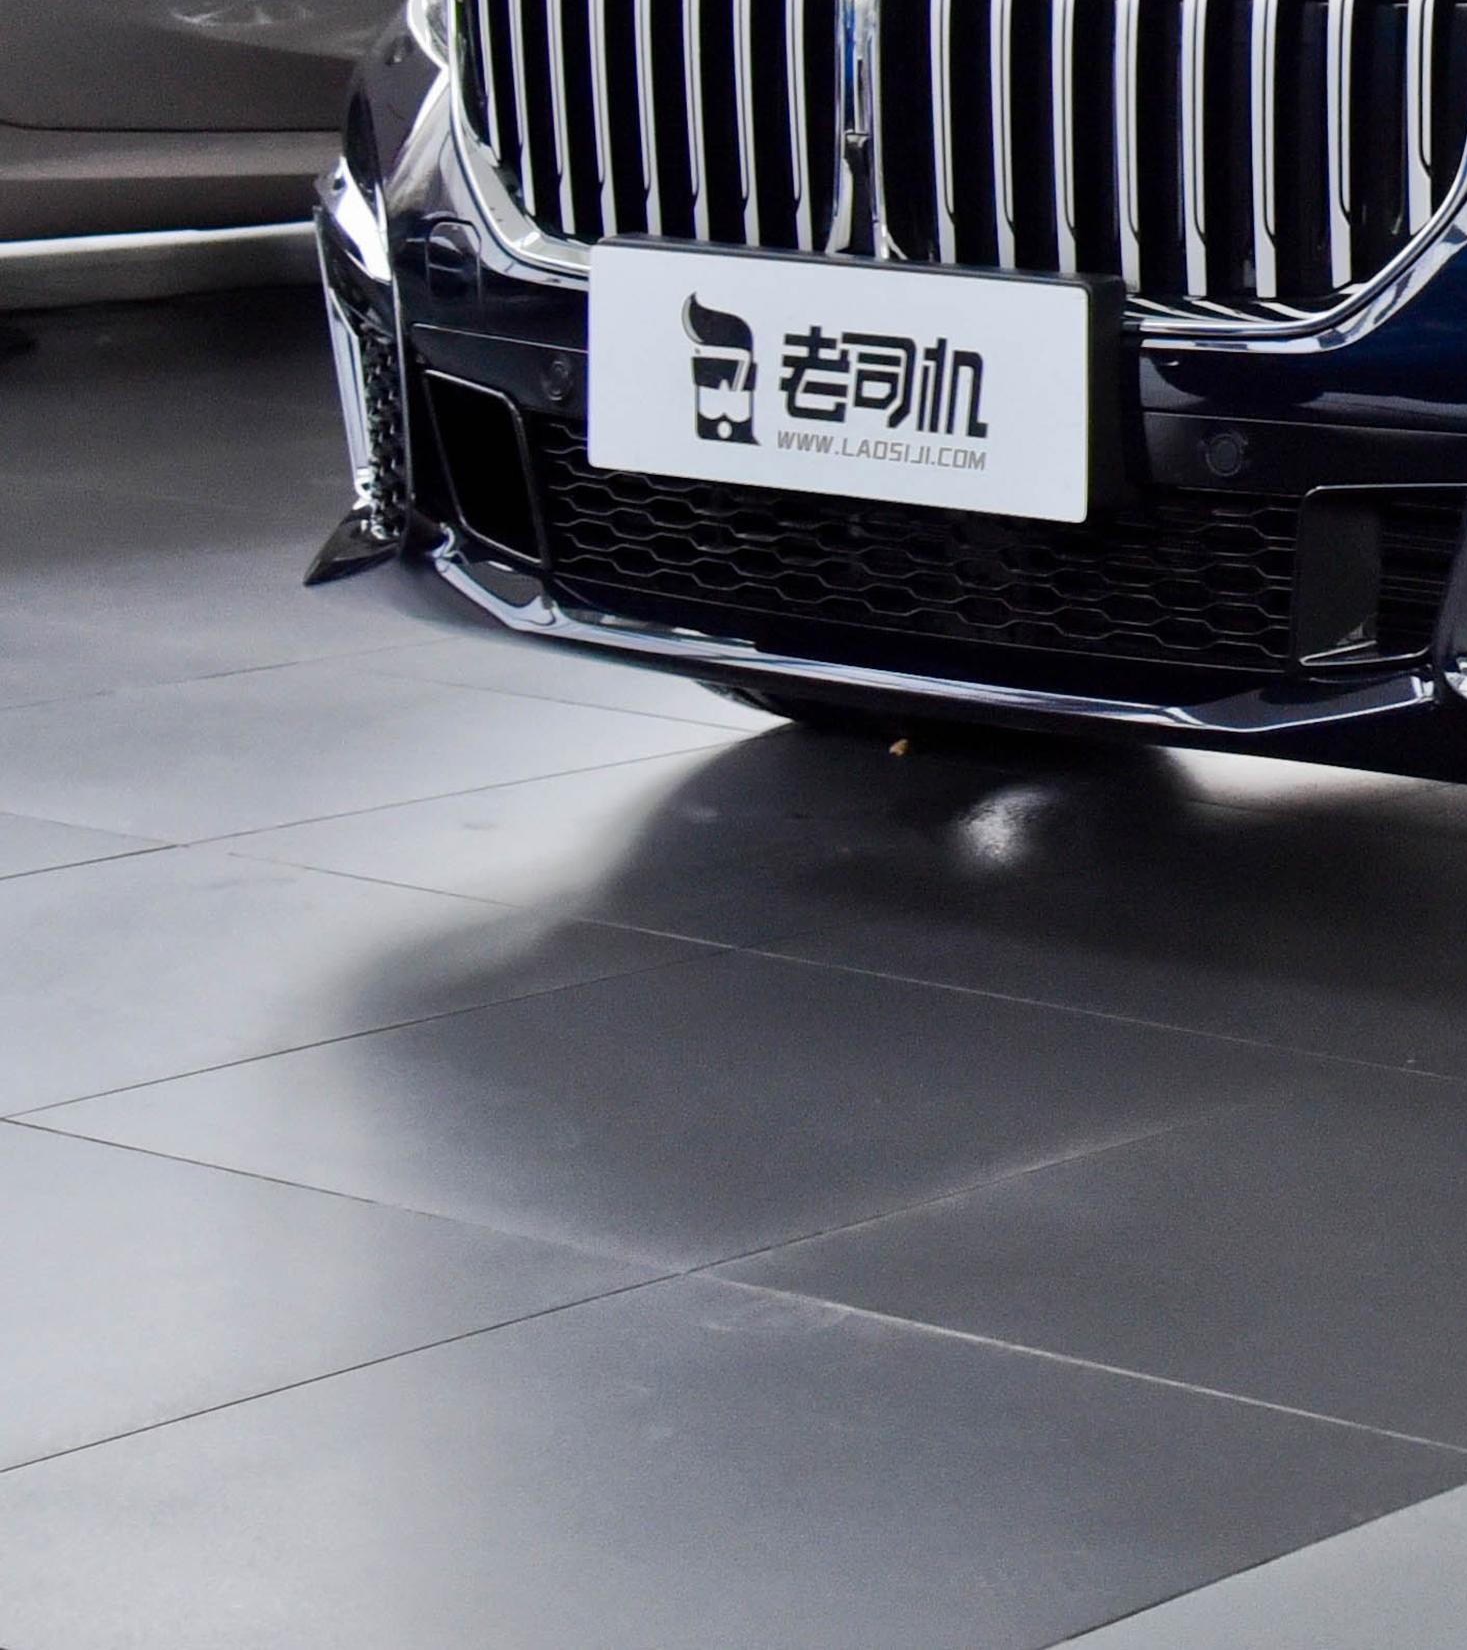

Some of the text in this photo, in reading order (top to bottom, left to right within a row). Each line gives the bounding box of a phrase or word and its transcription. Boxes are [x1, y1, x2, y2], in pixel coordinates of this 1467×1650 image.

[778, 325, 989, 439] 老司机
[777, 429, 987, 472] WWW.LAOSIJI.COM
